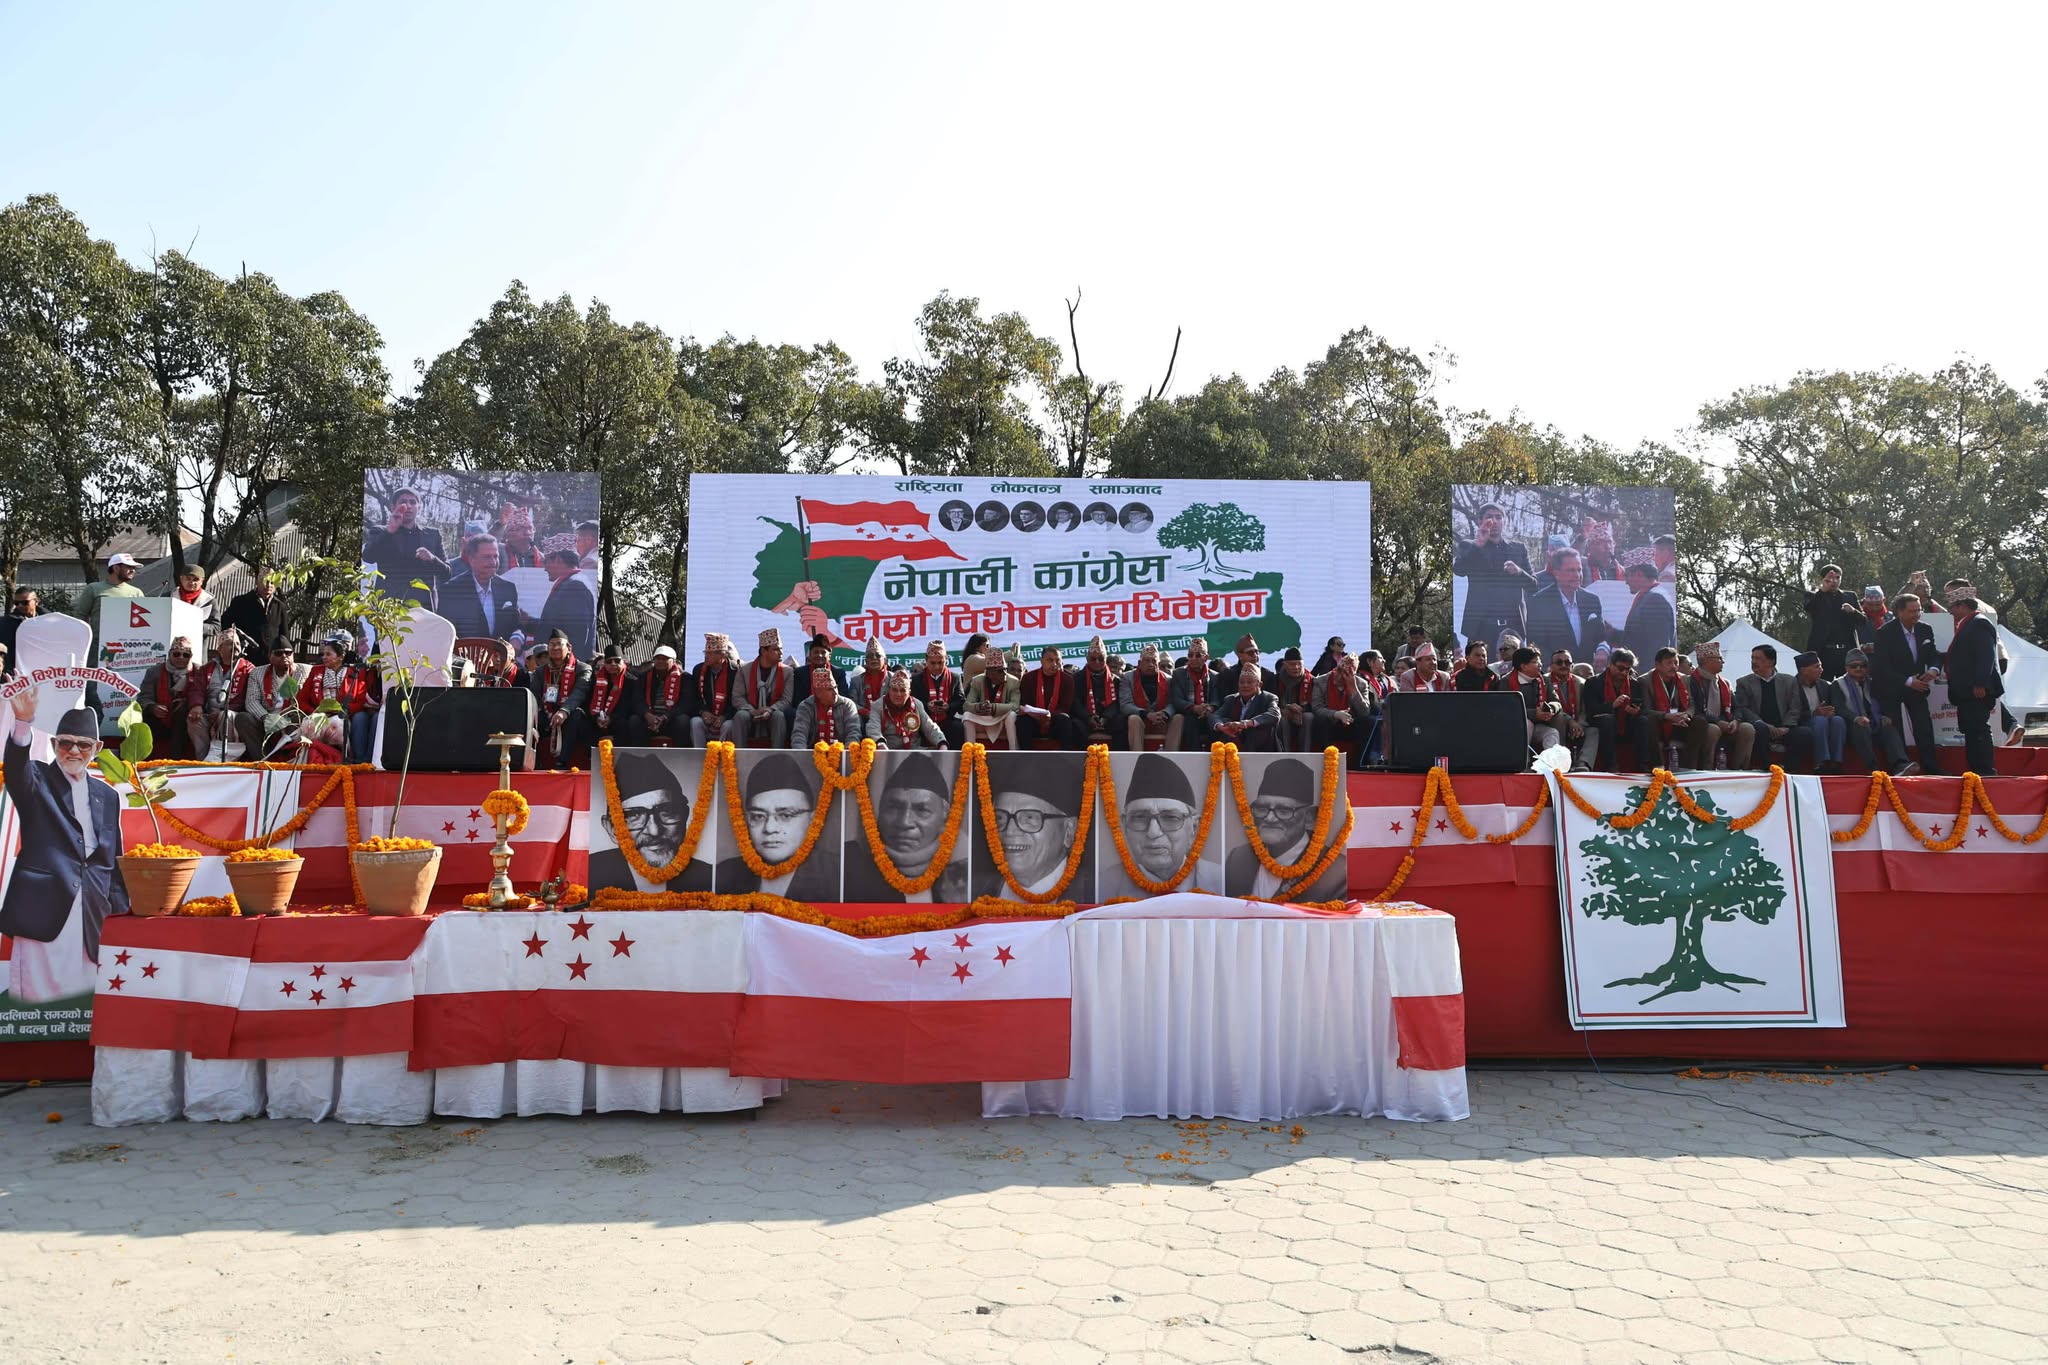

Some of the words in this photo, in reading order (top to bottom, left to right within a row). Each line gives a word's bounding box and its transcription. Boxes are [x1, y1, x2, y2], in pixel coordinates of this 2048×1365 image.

[894, 479, 964, 495] राष्ट्रियता
[990, 481, 1062, 494] लोकतन्त्र
[1088, 484, 1163, 495] समाजवाद
[884, 557, 1018, 601] नेपाली
[1033, 551, 1172, 592] कांग्रेस
[843, 606, 932, 643] दोस्रो
[940, 601, 1052, 635] विशेष
[1062, 590, 1268, 630] महाधिवेशन
[32, 666, 67, 683] विशेष
[71, 667, 139, 697] महाधिवेशन
[54, 679, 84, 689] २०८२
[0, 1009, 41, 1021] दलिएको
[43, 1008, 81, 1020] समयको
